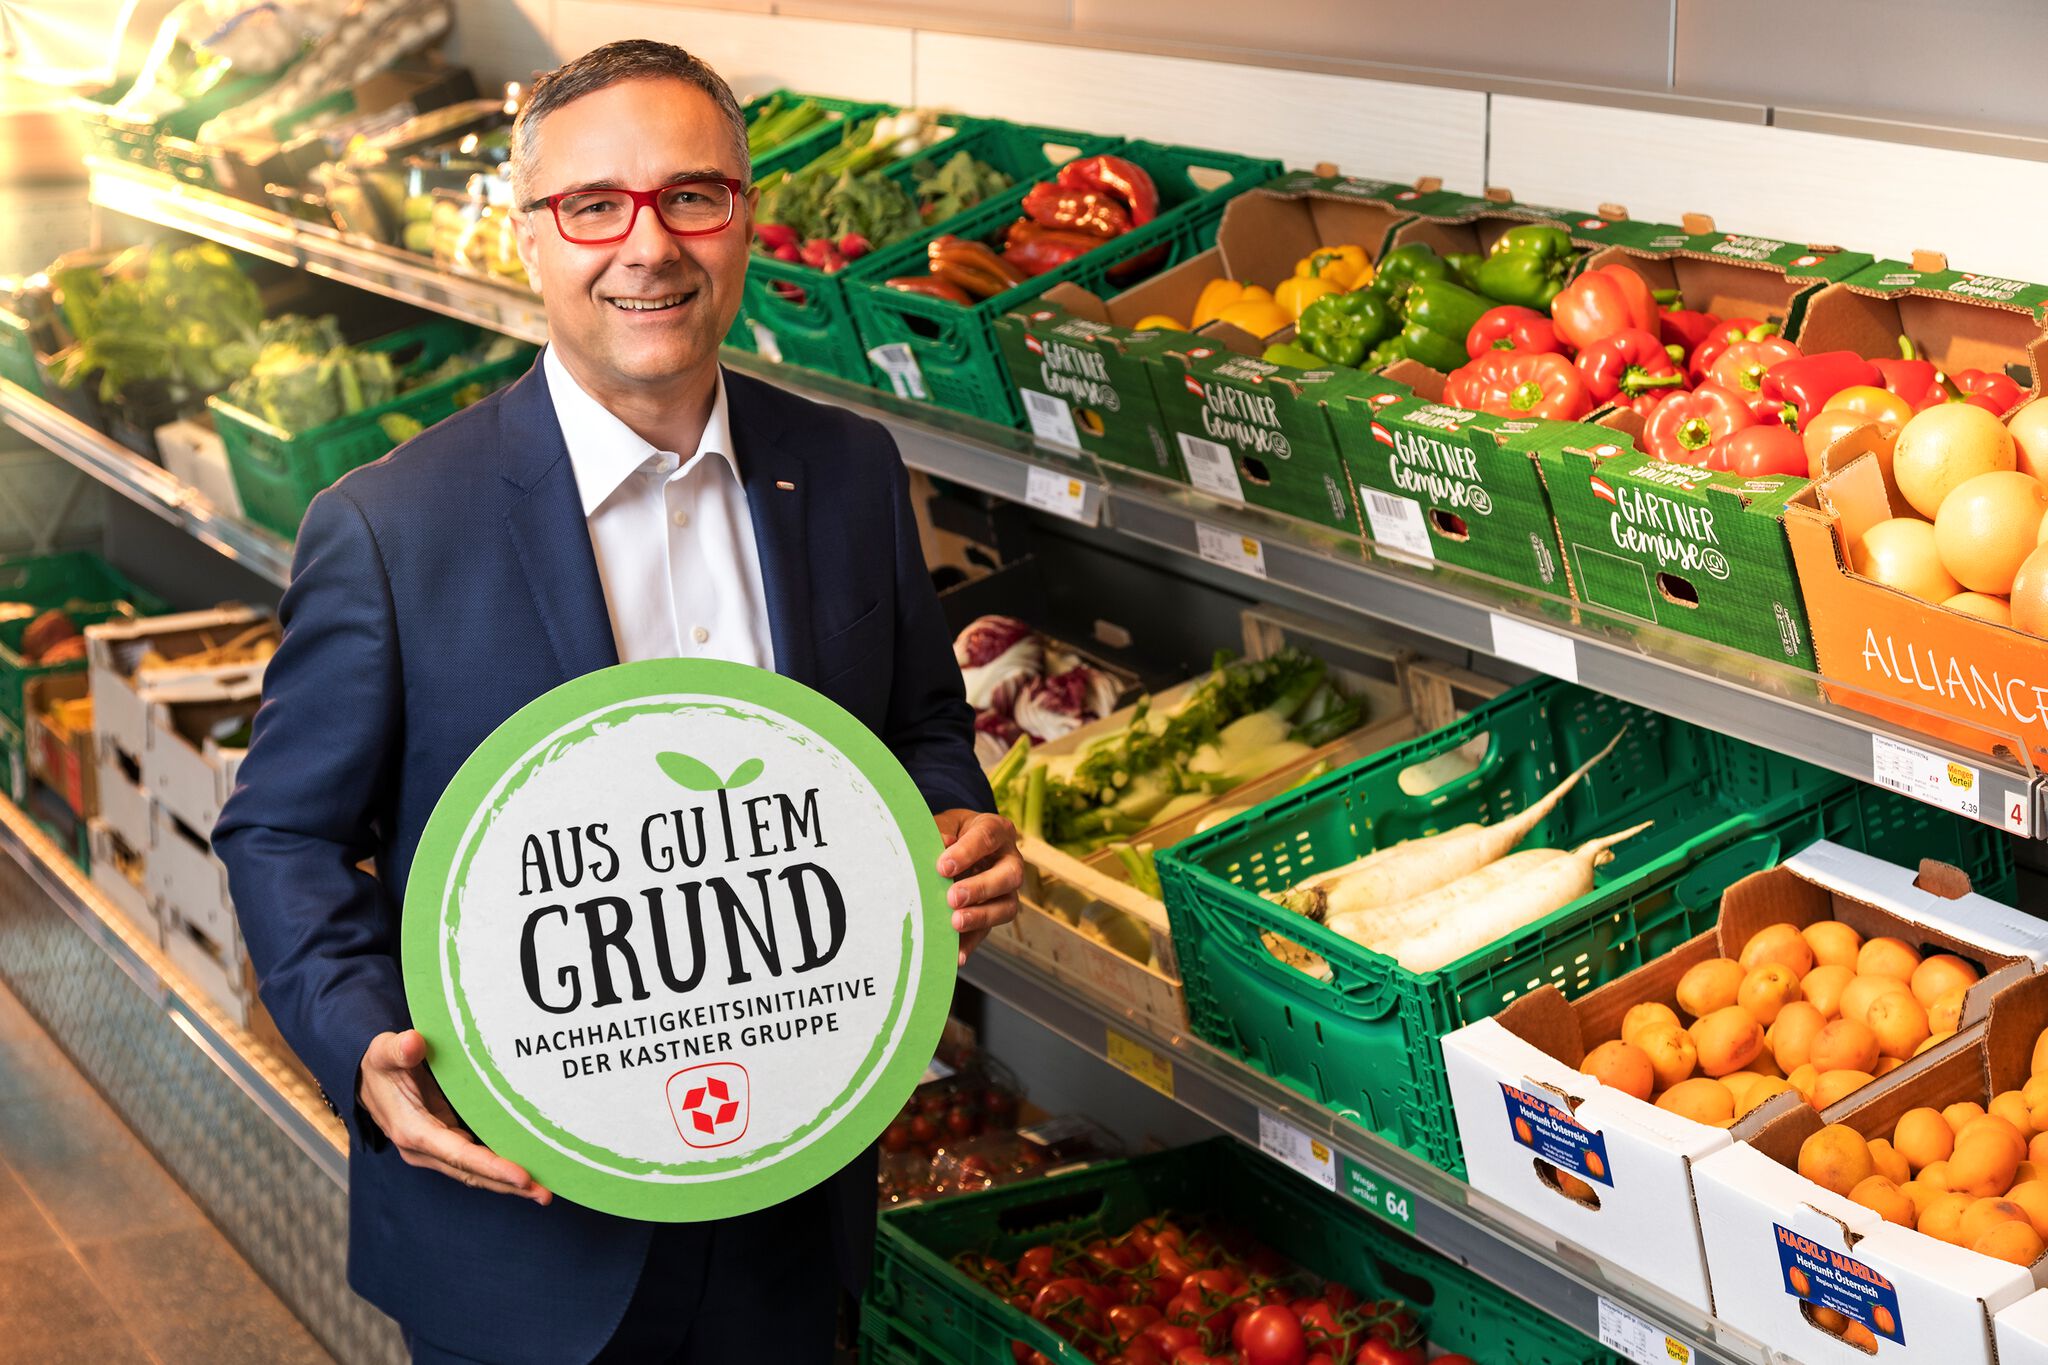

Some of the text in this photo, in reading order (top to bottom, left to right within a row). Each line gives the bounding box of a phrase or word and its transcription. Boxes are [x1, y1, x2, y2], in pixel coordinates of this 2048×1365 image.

[1042, 338, 1111, 383] GÄRTNER
[1204, 380, 1282, 430] GÄRTNER
[1201, 404, 1272, 454] Gemüse
[1393, 430, 1482, 483] GÄRTNER
[1389, 454, 1470, 507] Gemüse
[1618, 487, 1720, 545] GÄRTNER
[1610, 512, 1724, 571] Gemüse LGV
[1947, 763, 1974, 779] Mengen
[1948, 773, 1973, 787] Vorteil
[1961, 801, 1978, 814] 2,39
[2011, 803, 2023, 826] 4
[519, 787, 828, 896] AUS GUTEM
[519, 862, 847, 1015] GRUND
[514, 976, 877, 1059] NACHHALTIGKEITSINITIATIVE
[562, 1012, 839, 1080] DER KASTNER GRUPPE
[1519, 1105, 1551, 1128] Herkunft
[1551, 1118, 1590, 1145] Österreich
[1351, 1170, 1378, 1193] Wiege-
[1352, 1185, 1378, 1206] artikel
[1385, 1191, 1409, 1222] 64
[1796, 1253, 1879, 1298] Herkunft Österreich
[1665, 1346, 1689, 1363] Vorteil
